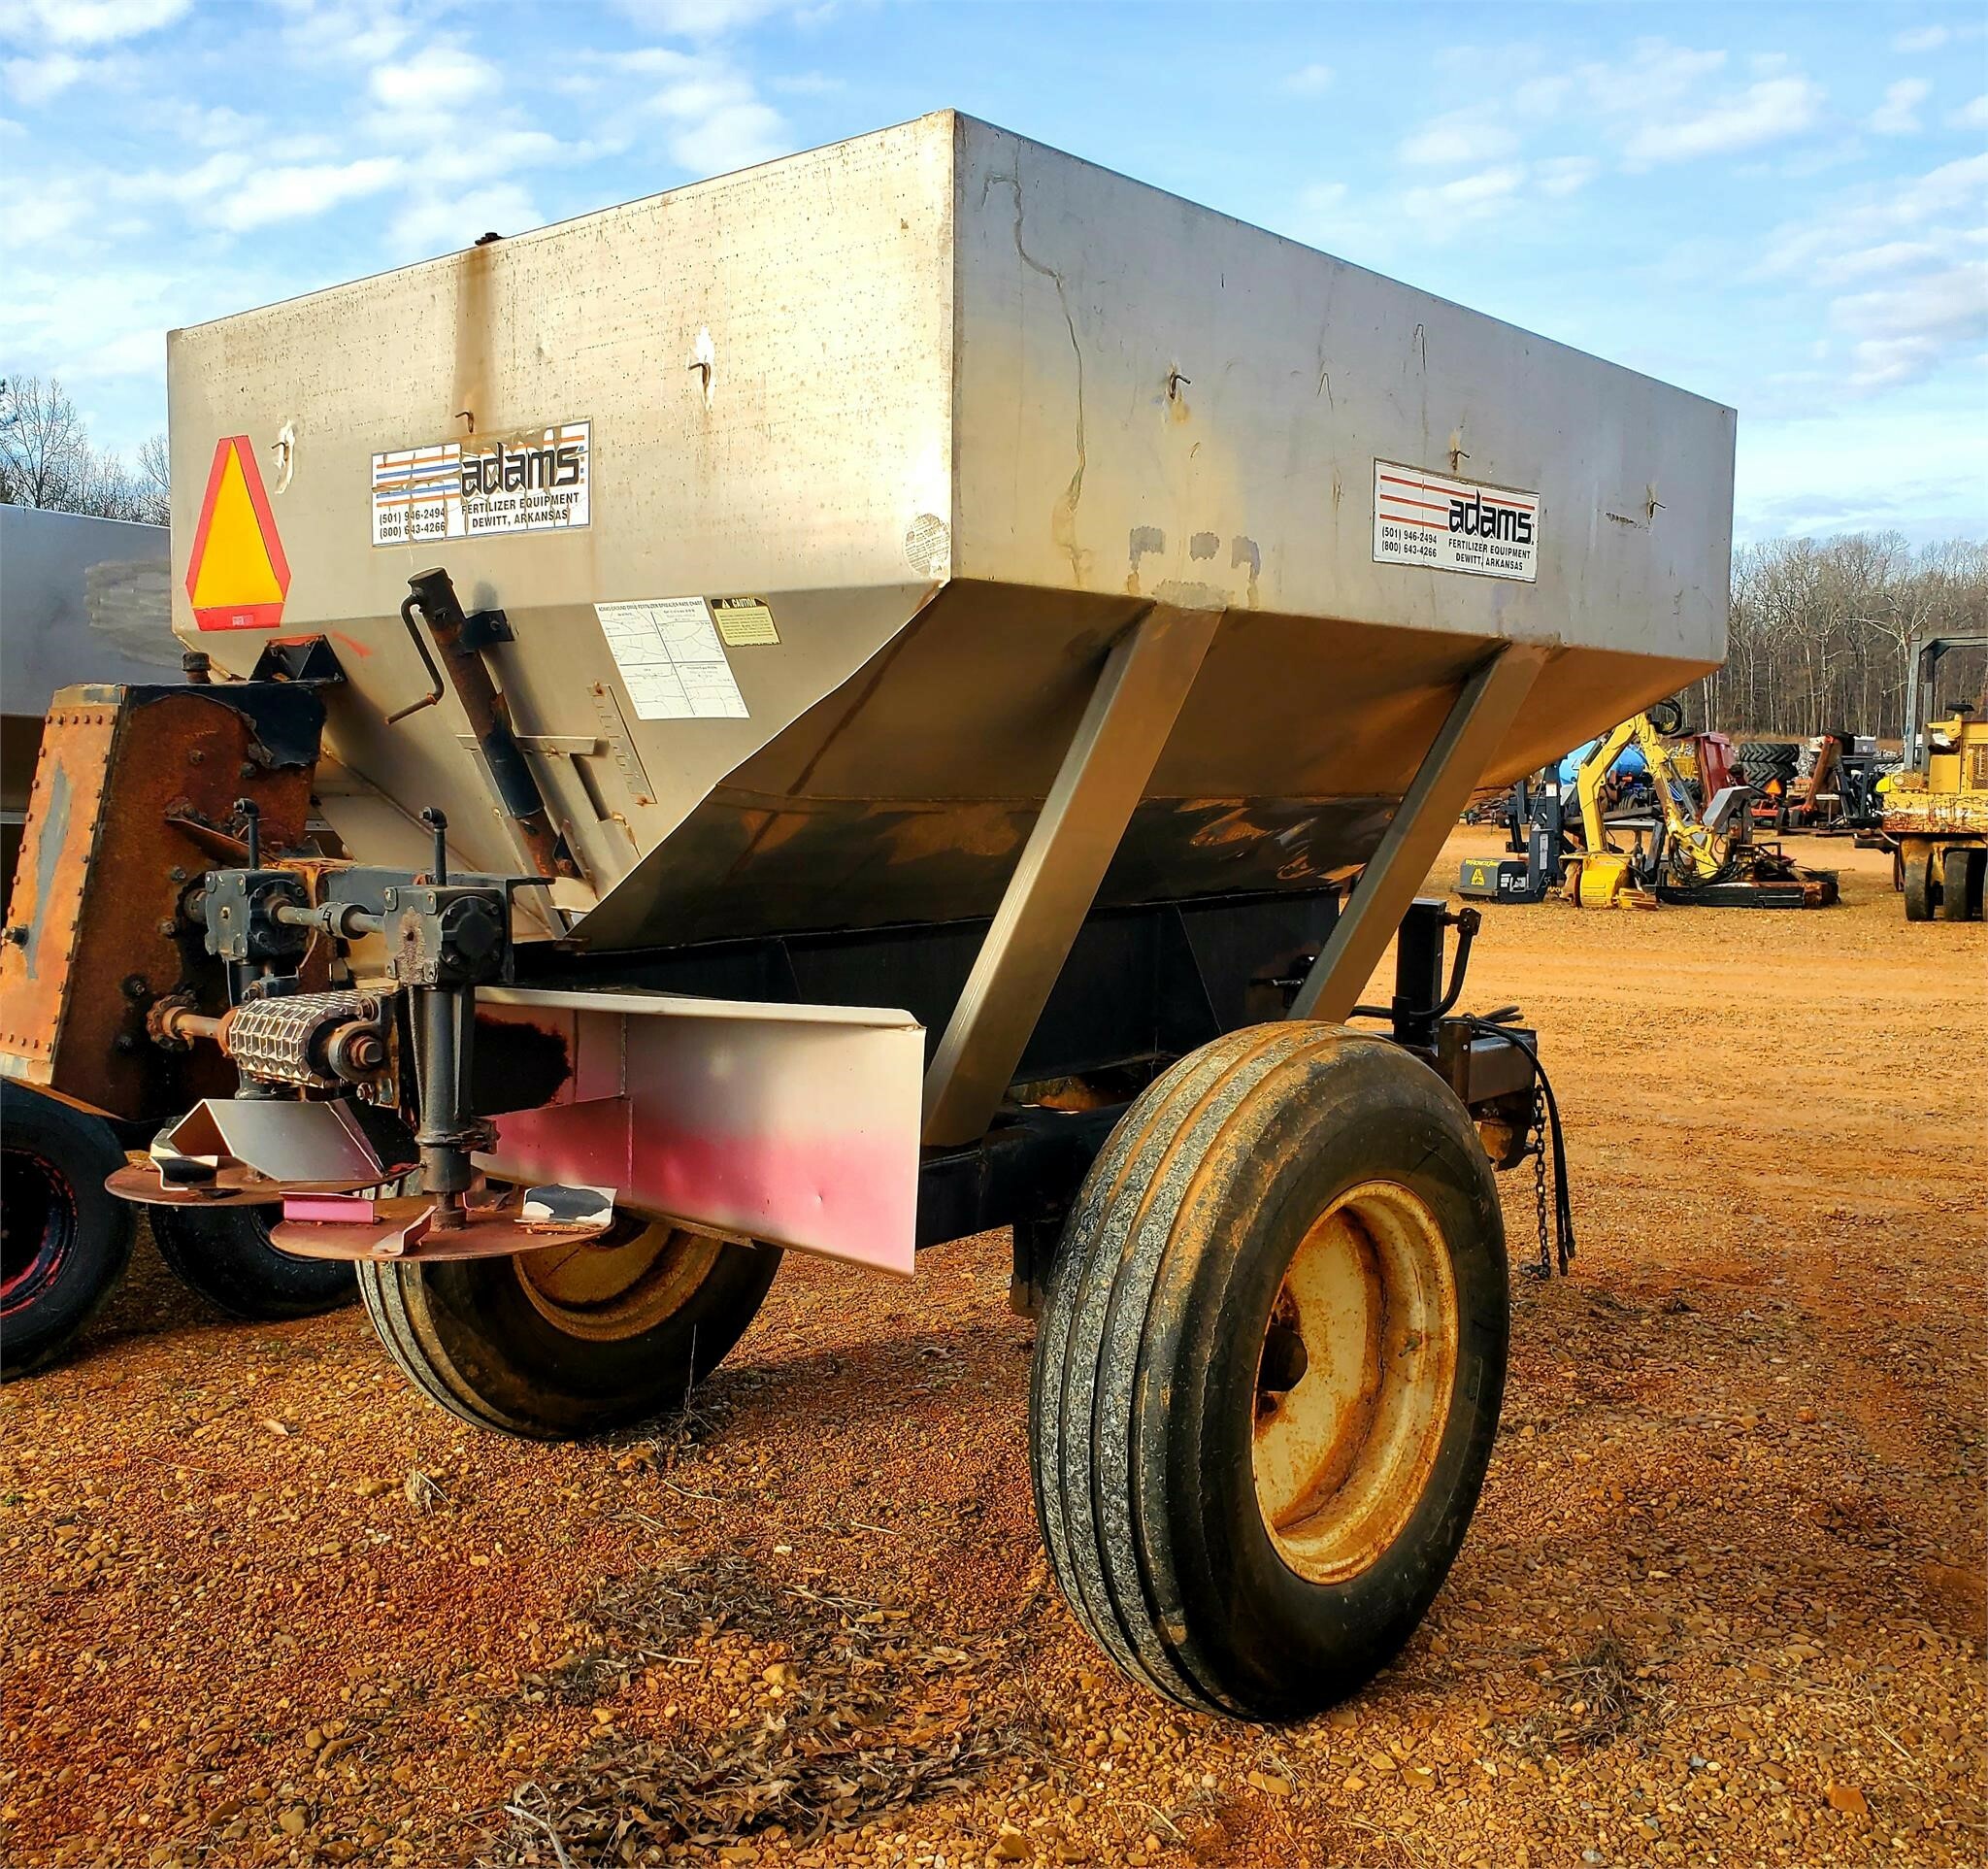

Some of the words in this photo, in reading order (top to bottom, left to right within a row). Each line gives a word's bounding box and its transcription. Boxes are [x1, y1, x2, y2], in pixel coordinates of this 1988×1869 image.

[461, 441, 580, 498] adams
[461, 499, 516, 516] FERTILIZER
[519, 492, 580, 509] EQUIPMENT
[380, 512, 402, 525] (501)
[404, 507, 446, 521] 946-2494
[472, 516, 512, 528] DEWITT,
[514, 509, 568, 524] ARKANSAS
[1448, 488, 1533, 545] adams
[380, 526, 402, 540] (800)
[404, 521, 446, 535] 643-4266
[1381, 526, 1402, 540] (501)
[1404, 530, 1438, 545] 946-2494
[1381, 540, 1402, 554] (800)
[1404, 545, 1438, 558] 643-4266
[1448, 538, 1489, 553] FERTILIZER
[1490, 545, 1531, 559] EQUIPMENT
[1485, 557, 1523, 571] ARKANSAS
[731, 597, 757, 608] CAUTION
